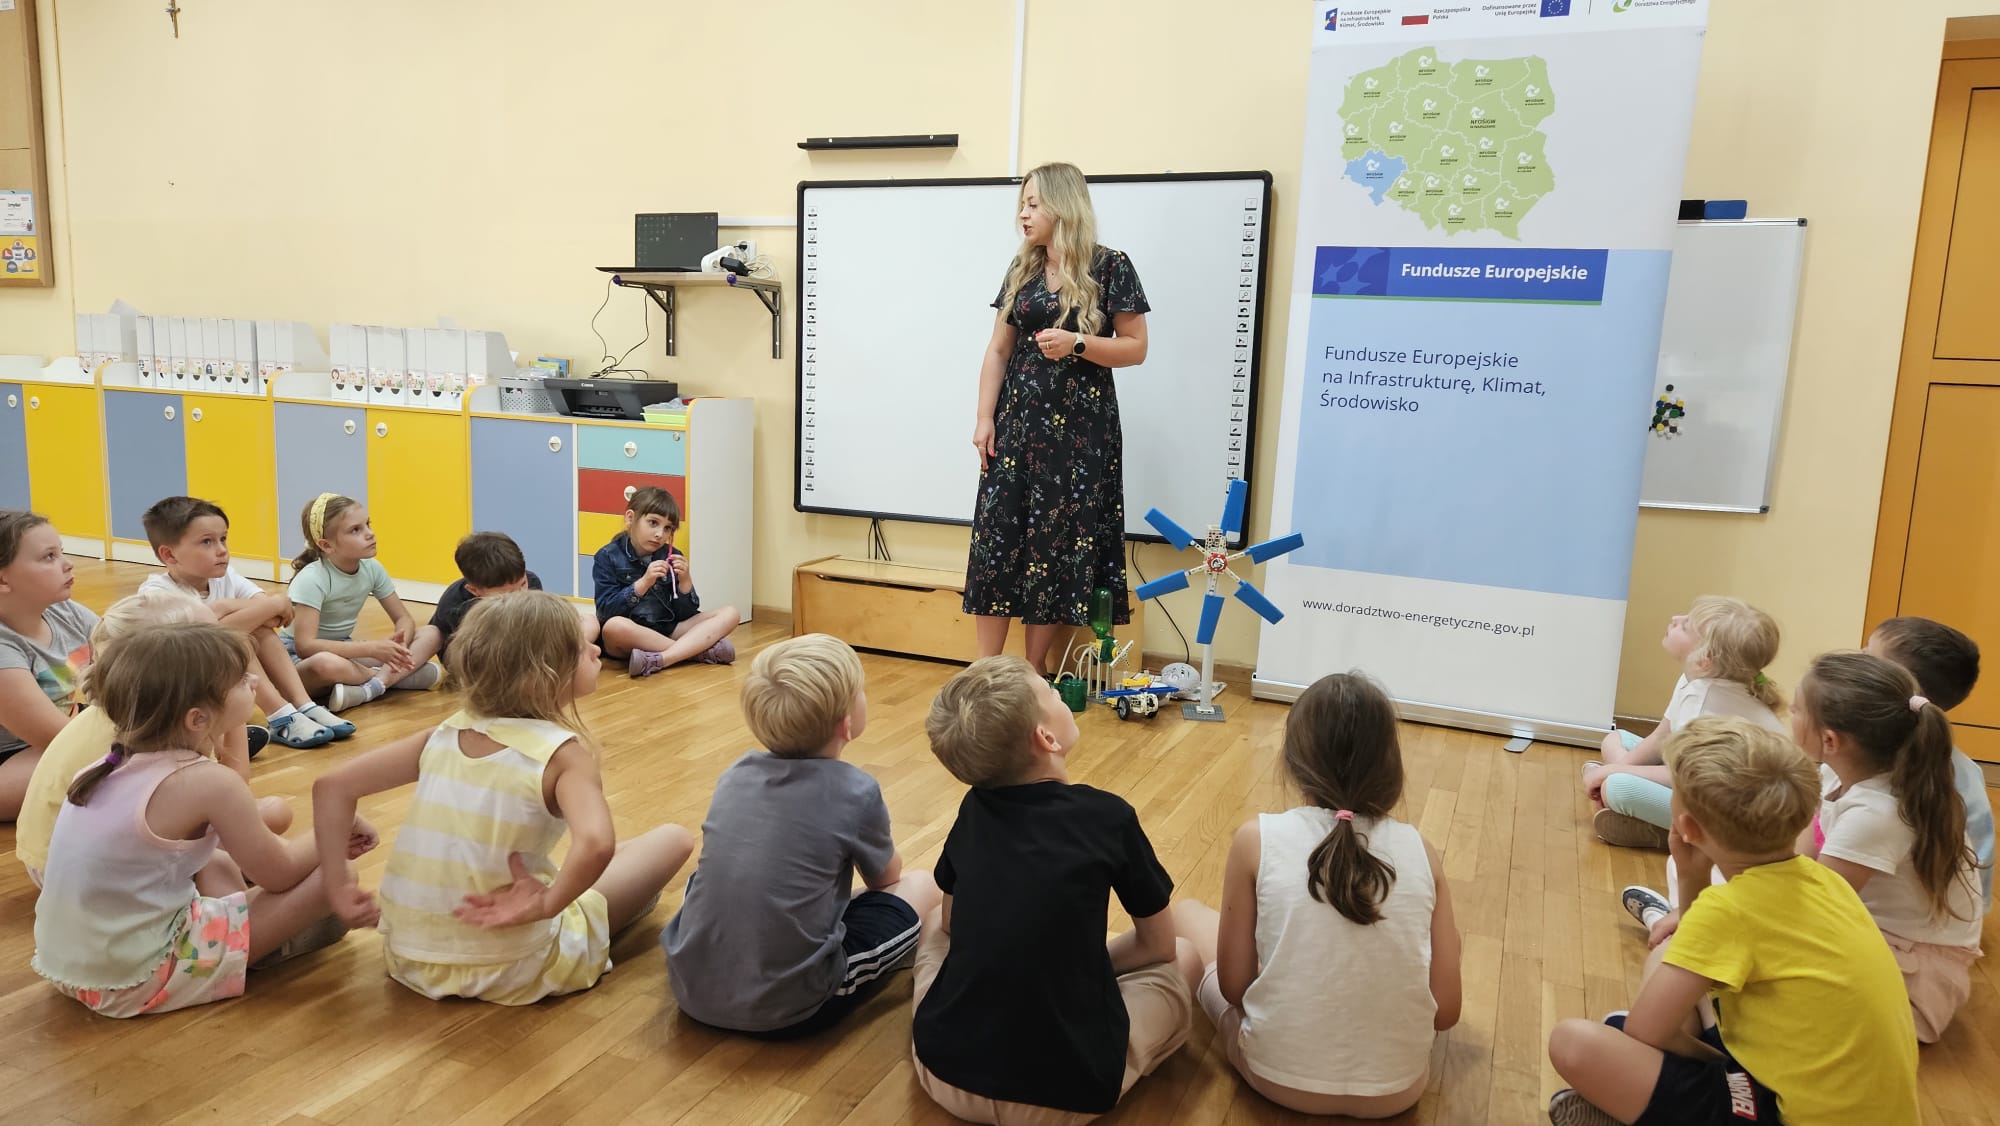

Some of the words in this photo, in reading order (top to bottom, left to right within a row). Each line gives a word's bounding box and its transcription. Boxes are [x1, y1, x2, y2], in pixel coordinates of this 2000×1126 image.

[1357, 20, 1385, 28] Środowisko
[1363, 8, 1392, 16] Europejskie
[1401, 263, 1481, 278] Fundusze
[1484, 264, 1588, 282] Europejskie
[1324, 346, 1407, 364] Fundusze
[1412, 349, 1519, 371] Europejskie
[1322, 371, 1343, 384] na
[1348, 370, 1476, 394] Infrastrukturę,
[1482, 377, 1547, 397] Klimat,
[1319, 389, 1419, 412] Środowisko
[1302, 599, 1535, 638] www.doradztwo-energetyczne.gov.pl
[1726, 1072, 1755, 1116] MARVEL
